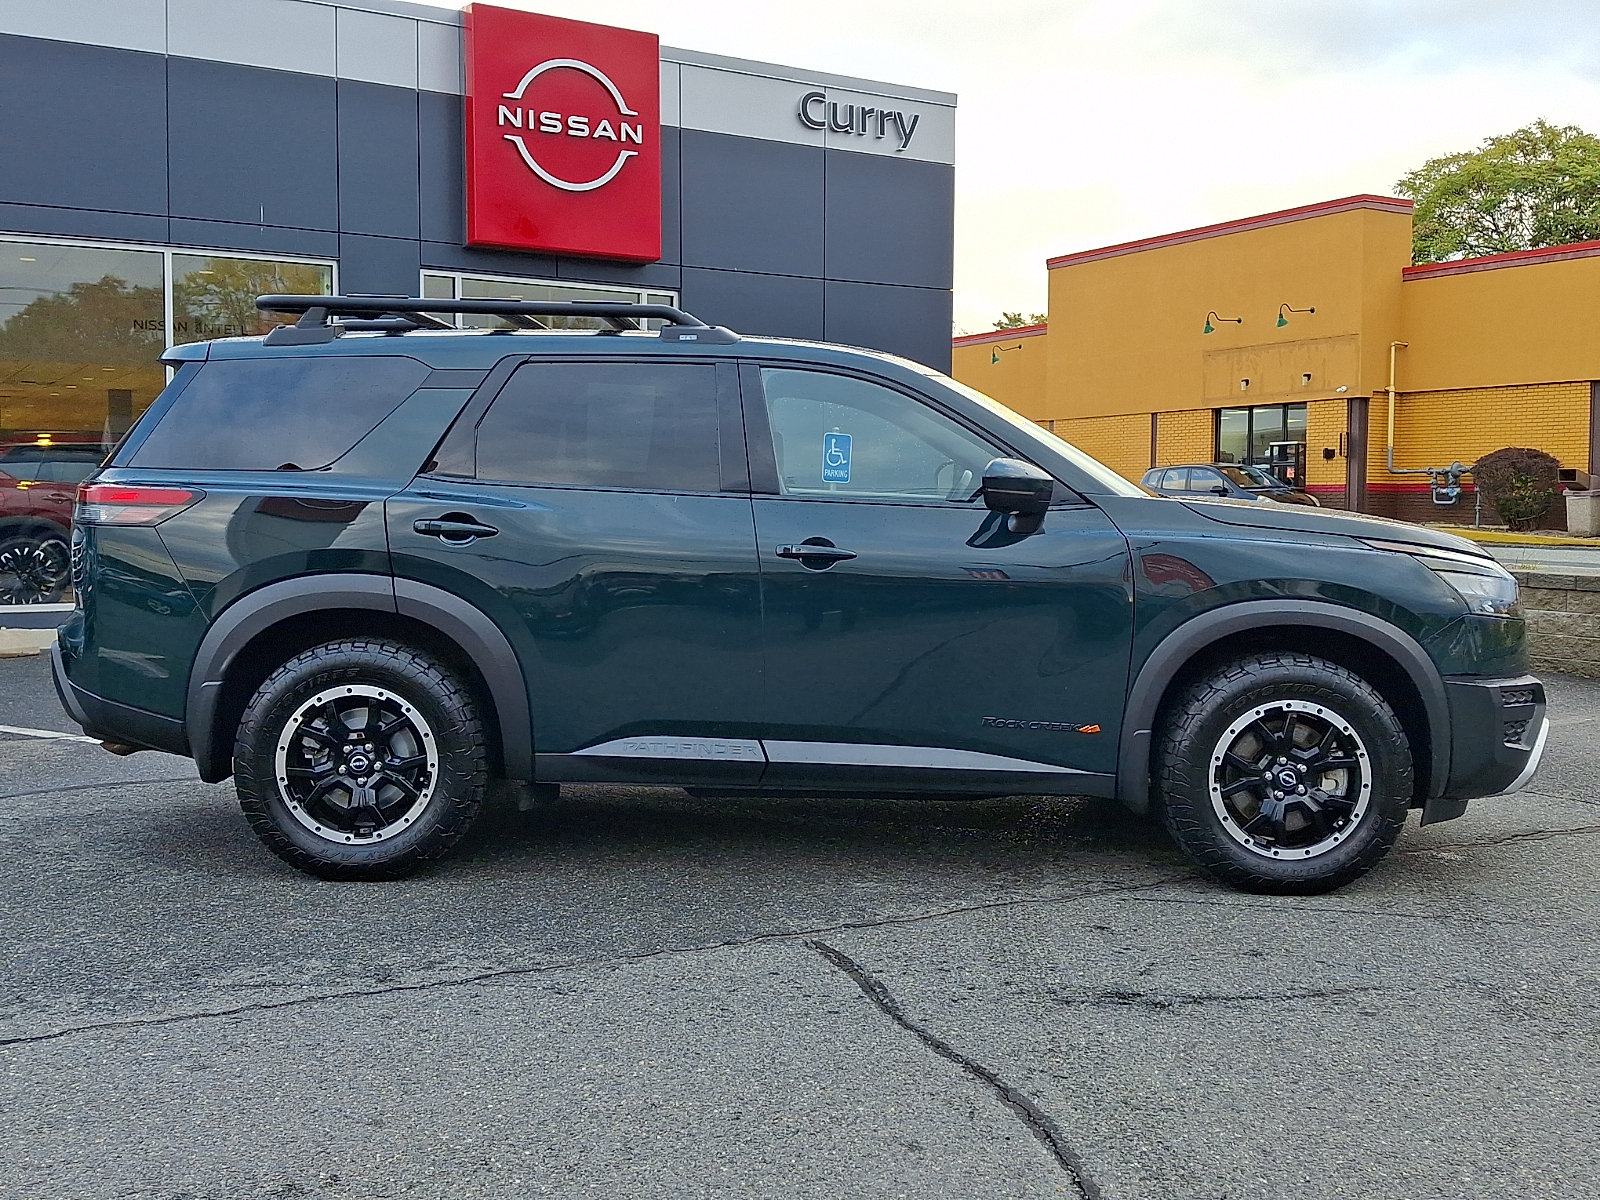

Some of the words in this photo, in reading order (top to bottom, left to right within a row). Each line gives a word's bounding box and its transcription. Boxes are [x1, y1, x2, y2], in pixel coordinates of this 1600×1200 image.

[498, 104, 643, 144] NISSAN
[799, 90, 920, 151] Curry
[824, 468, 848, 478] PARKING
[981, 716, 1026, 728] ROCK
[1028, 721, 1081, 732] CREEK
[623, 741, 758, 756] PATHFINDER
